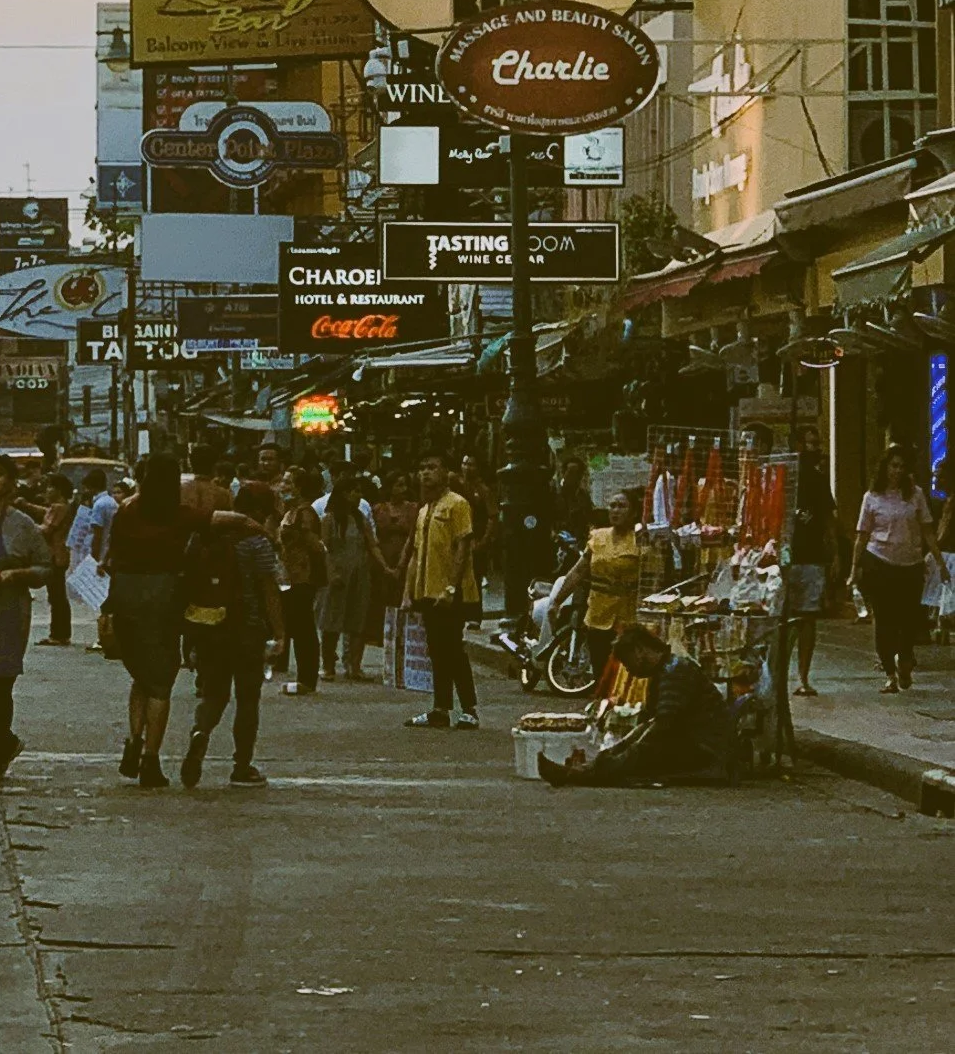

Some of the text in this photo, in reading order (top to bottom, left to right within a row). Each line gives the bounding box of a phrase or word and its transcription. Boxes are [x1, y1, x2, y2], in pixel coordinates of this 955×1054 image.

[146, 35, 206, 55] Balcony
[450, 9, 652, 66] MASSAGE AND BEAUTY SALON
[492, 49, 610, 85] Charlie
[529, 235, 575, 252] OOM
[458, 255, 545, 264] WINE CEAR
[295, 293, 425, 305] HOTEL & RESTAURANT
[86, 340, 198, 360] TATOO
